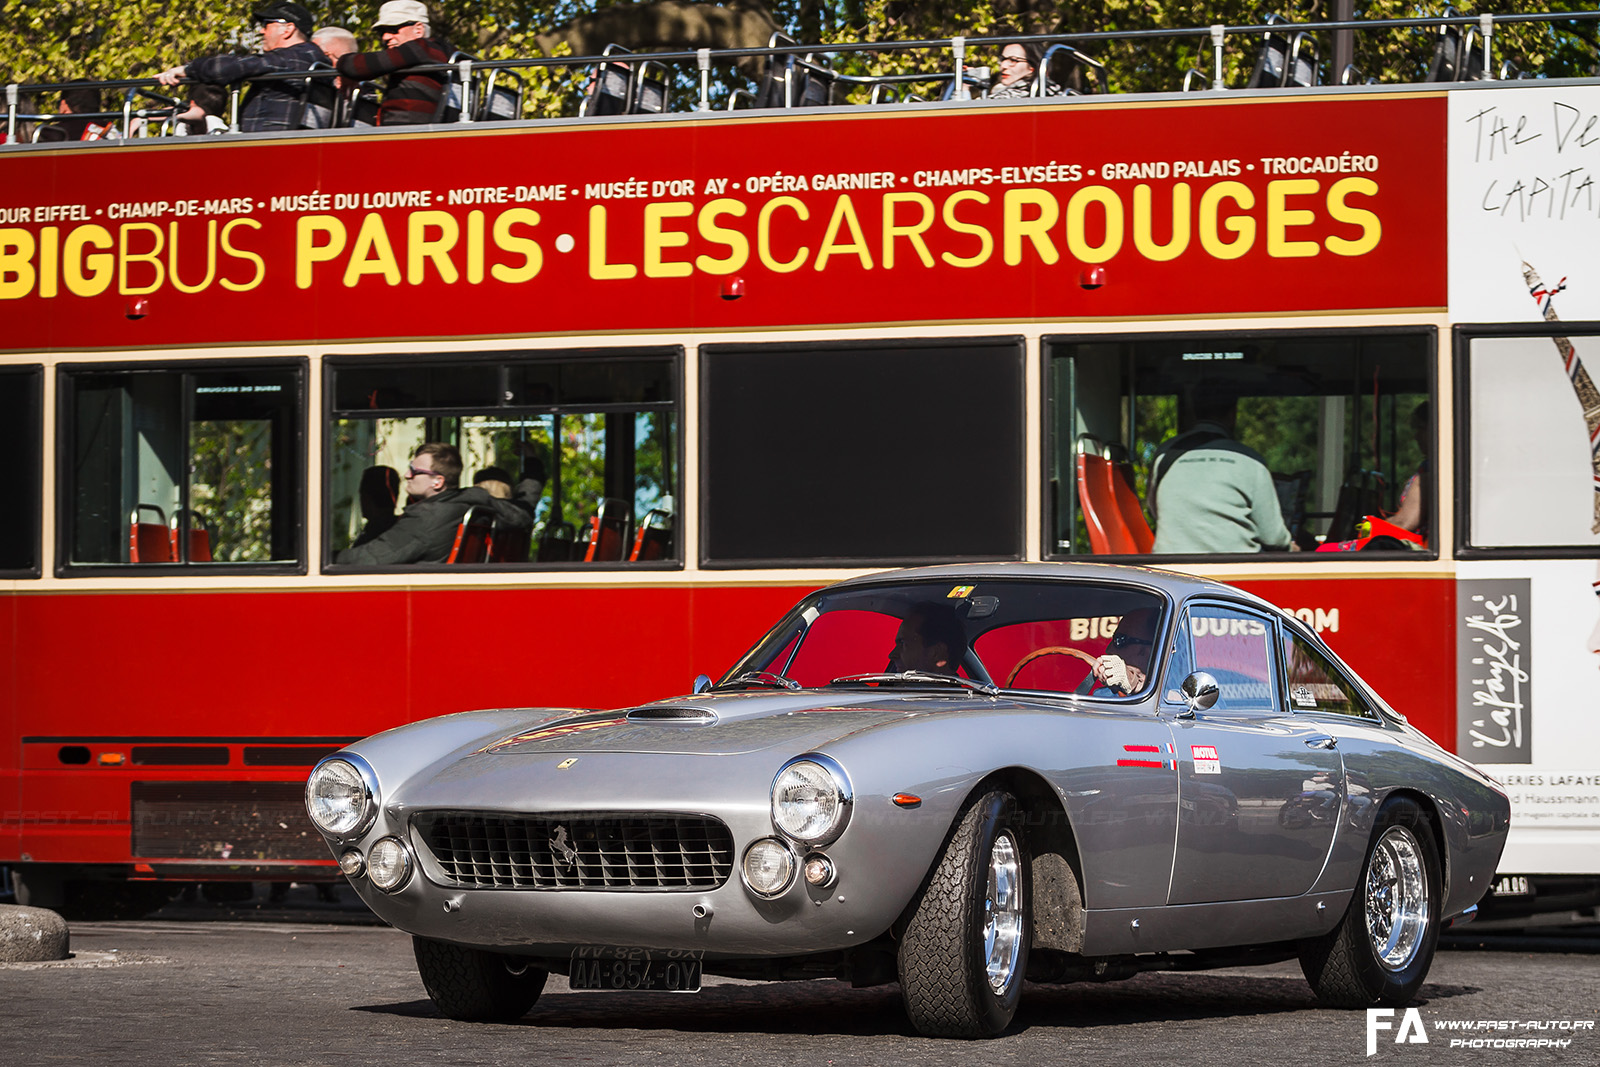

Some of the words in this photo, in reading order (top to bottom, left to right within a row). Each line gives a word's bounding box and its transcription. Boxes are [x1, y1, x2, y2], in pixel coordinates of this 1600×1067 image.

[34, 204, 92, 222] EIFFEL
[107, 197, 254, 219] CHAMP-DE-MARS
[270, 189, 332, 212] MUSÉE
[334, 194, 360, 210] DU
[363, 190, 432, 209] LOUVRE
[448, 184, 567, 205] NOTRE-DAME
[584, 177, 649, 199] MUSÉE
[745, 170, 809, 193] OPÉRA
[811, 172, 896, 191] GARNIER
[912, 160, 1083, 188] CHAMPS-ELYSÉES
[1101, 162, 1170, 180] GRAND
[1172, 159, 1241, 178] PALAIS
[1260, 150, 1379, 175] TROCADÉRO
[295, 207, 544, 290] PARIS
[1193, 746, 1218, 760] MOTUL
[1500, 775, 1545, 786] LERIES
[1525, 793, 1600, 804] Haussmann
